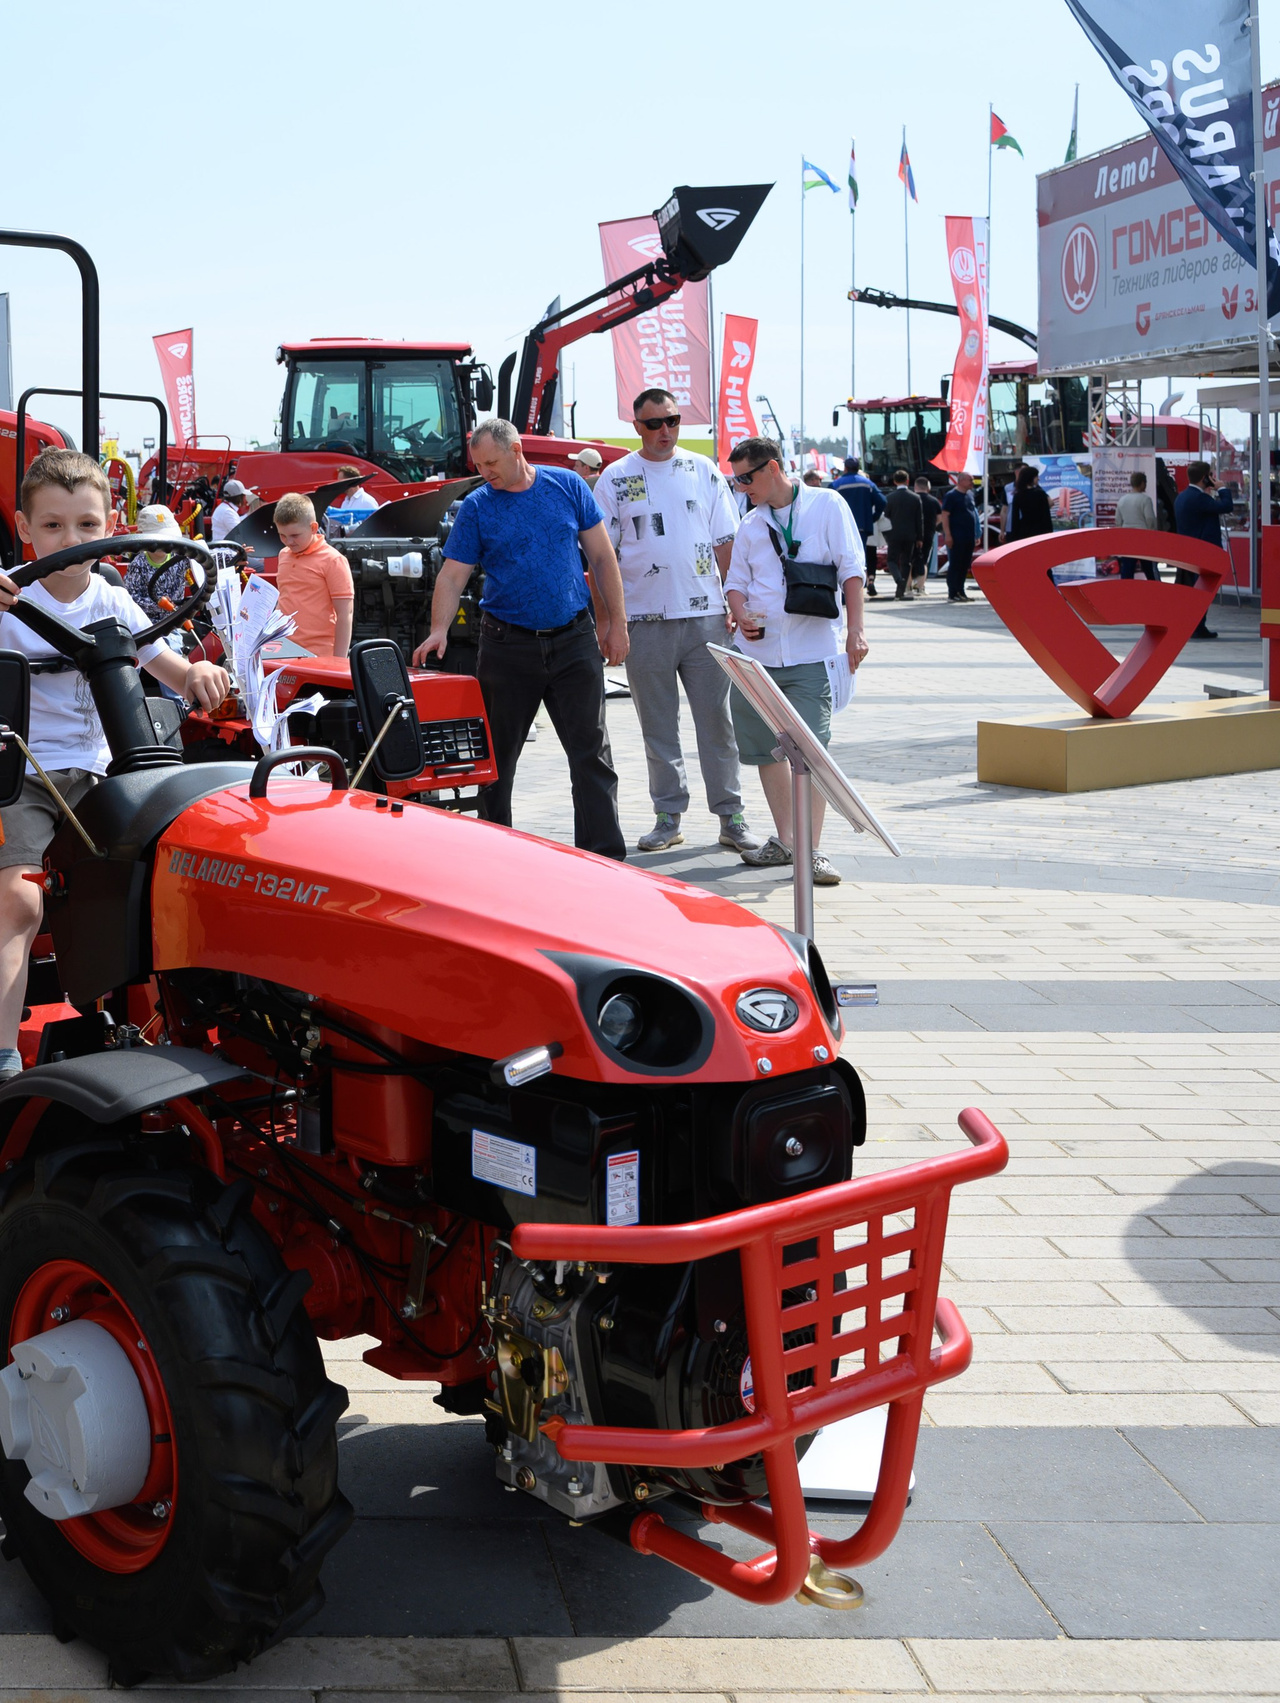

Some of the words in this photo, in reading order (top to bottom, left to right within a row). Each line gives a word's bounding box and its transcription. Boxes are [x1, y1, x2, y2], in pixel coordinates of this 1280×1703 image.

[1094, 146, 1158, 199] Лето!
[1113, 271, 1159, 297] Техника
[1162, 256, 1218, 286] лидеров
[1222, 251, 1247, 275] агр
[528, 397, 538, 424] BELARUS
[278, 674, 297, 685] ARUS
